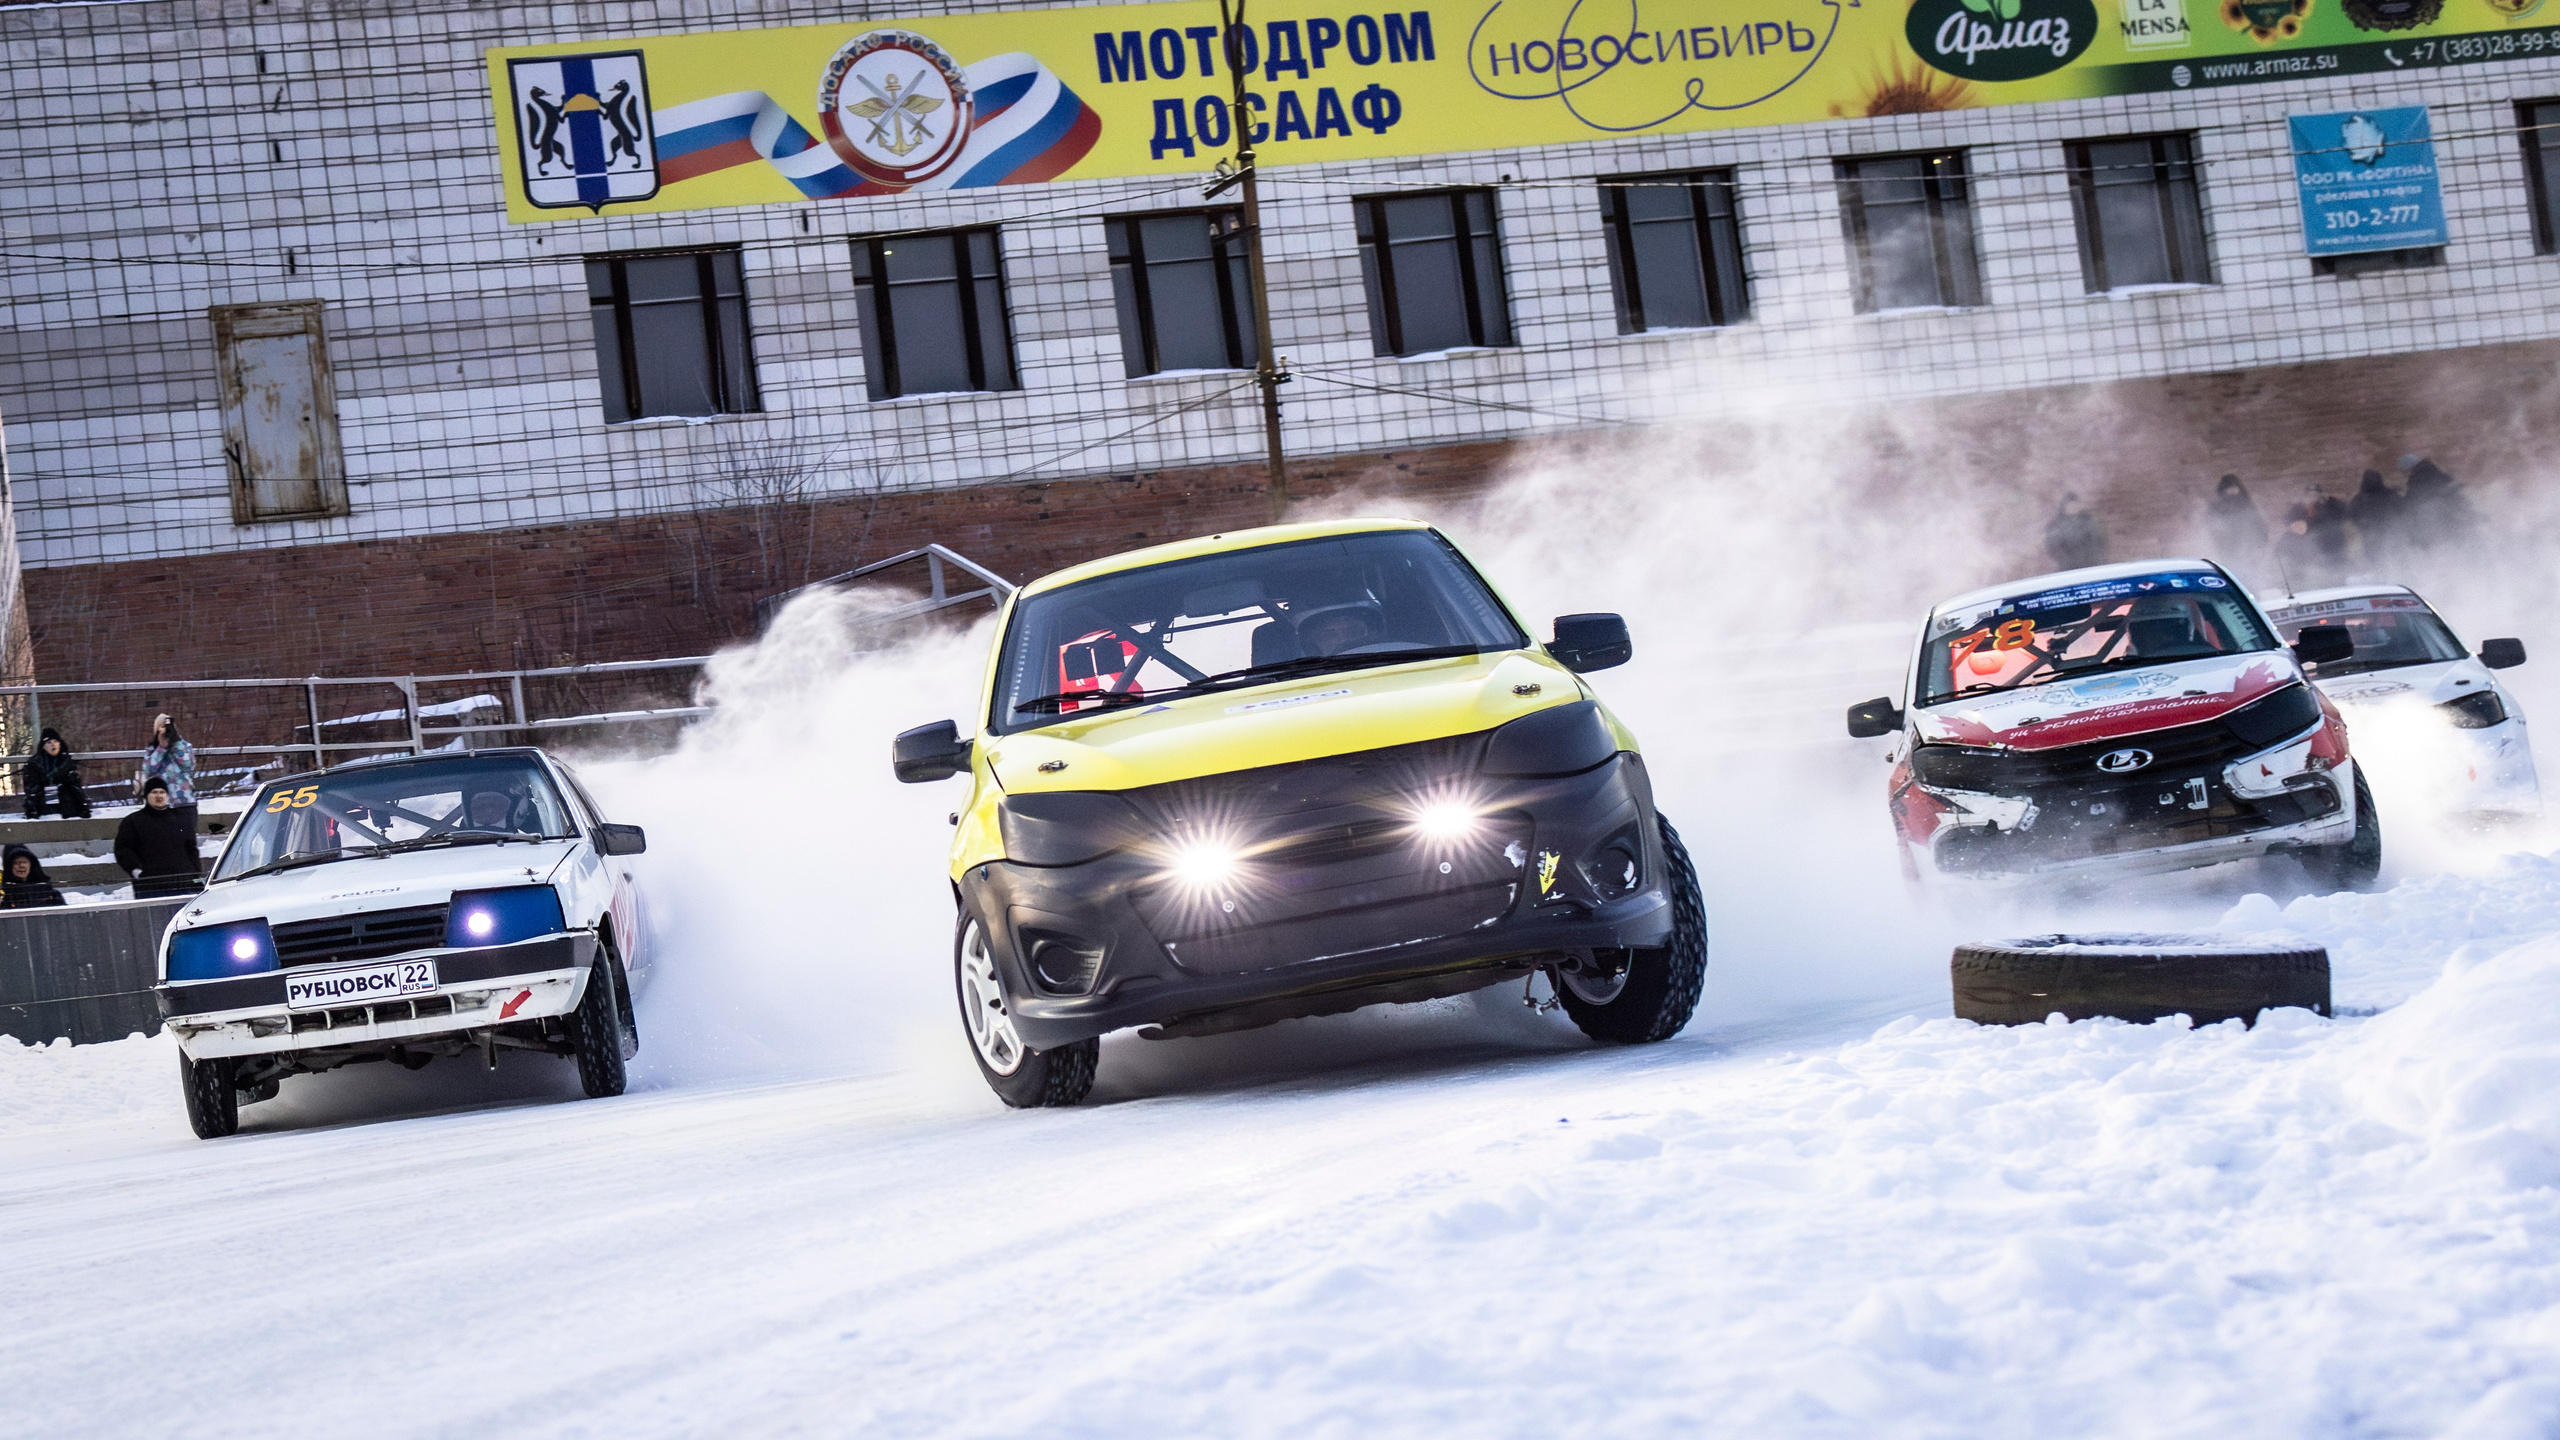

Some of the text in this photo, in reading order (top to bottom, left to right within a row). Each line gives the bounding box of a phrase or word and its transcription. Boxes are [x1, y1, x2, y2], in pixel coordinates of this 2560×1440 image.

[2138, 0, 2166, 12] LA
[1934, 10, 2071, 66] Армаз
[2120, 16, 2191, 37] MENSA
[1094, 11, 1436, 83] МОТОДРОМ
[1488, 20, 1816, 77] НОВОСИБИРЬ
[2410, 41, 2436, 61] +7
[820, 30, 969, 108] ДОСААФ РОССИИ
[2202, 53, 2339, 80] www.armaz.su
[1149, 83, 1402, 161] ДОСААФ
[2301, 171, 2334, 185] ООО
[2325, 204, 2420, 230] 310-2-777
[1947, 618, 2036, 671] 78
[266, 784, 320, 813] 55
[289, 964, 429, 1000] РУБЦОВСК 22
[402, 982, 421, 992] RUS
